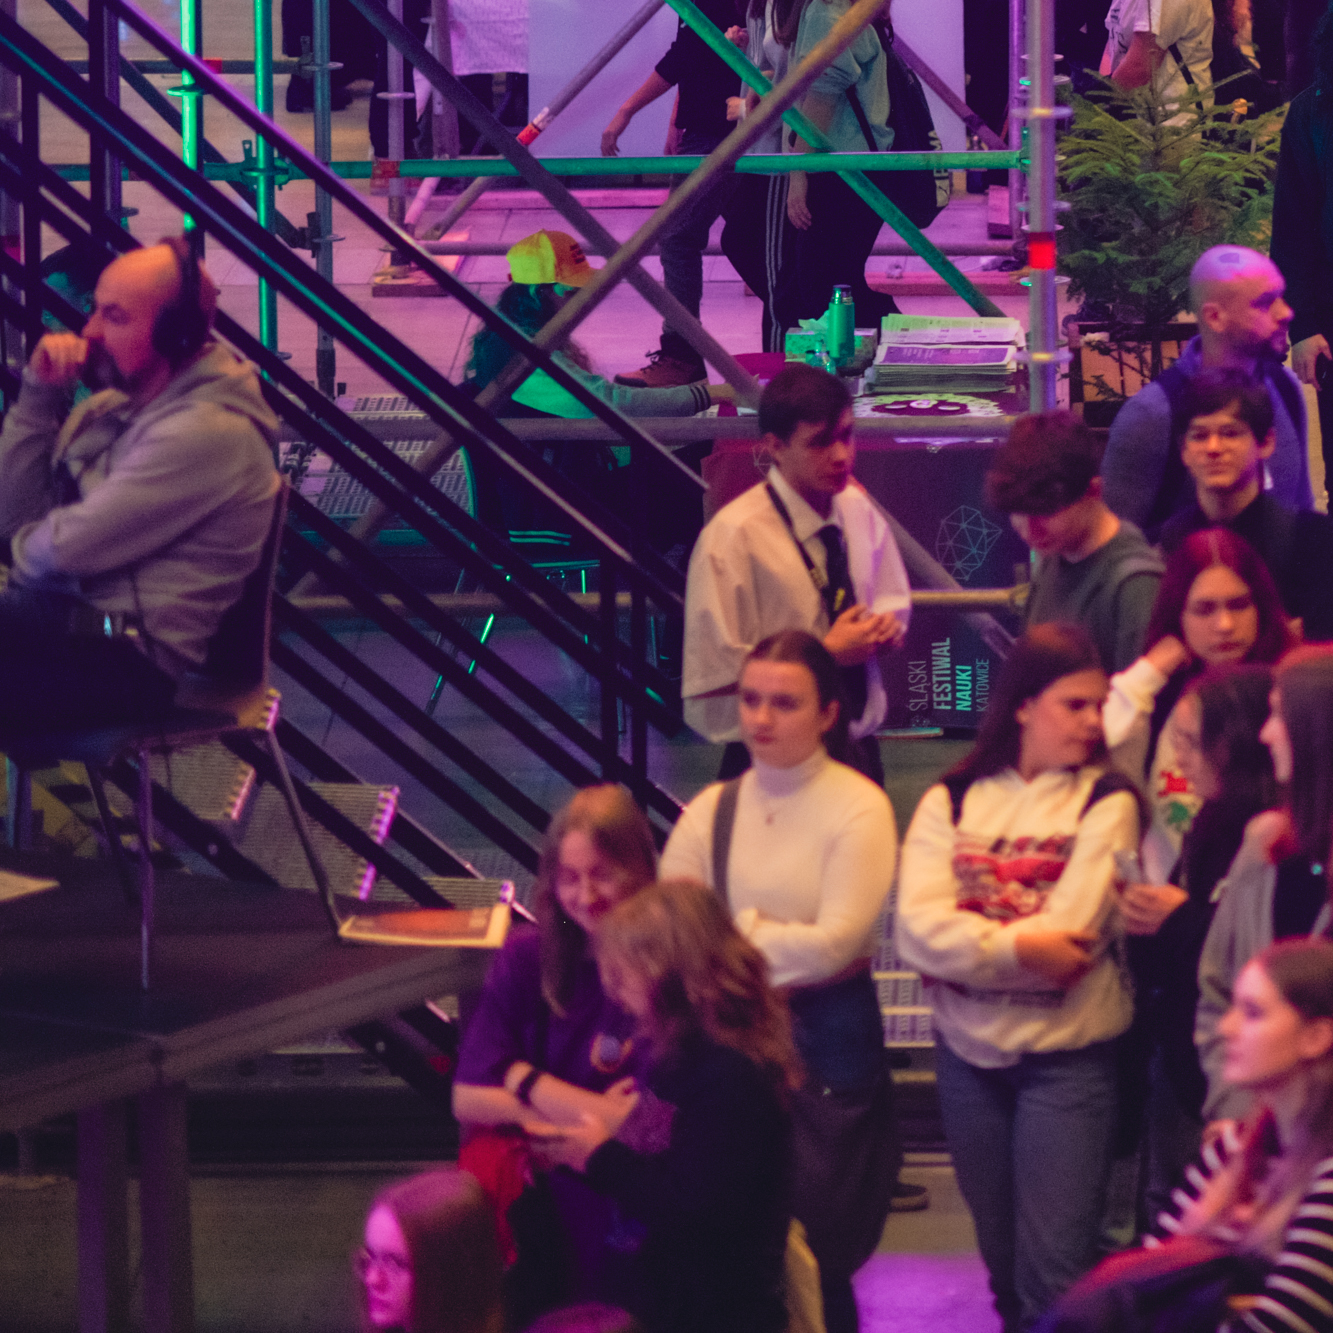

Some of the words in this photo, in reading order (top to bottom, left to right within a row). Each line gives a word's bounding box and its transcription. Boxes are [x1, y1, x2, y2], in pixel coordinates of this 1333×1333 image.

[906, 660, 931, 712] ŚLĄSKI
[931, 637, 952, 710] FESTIWAL
[955, 665, 972, 712] NAUKI
[975, 658, 990, 712] KATOWICE
